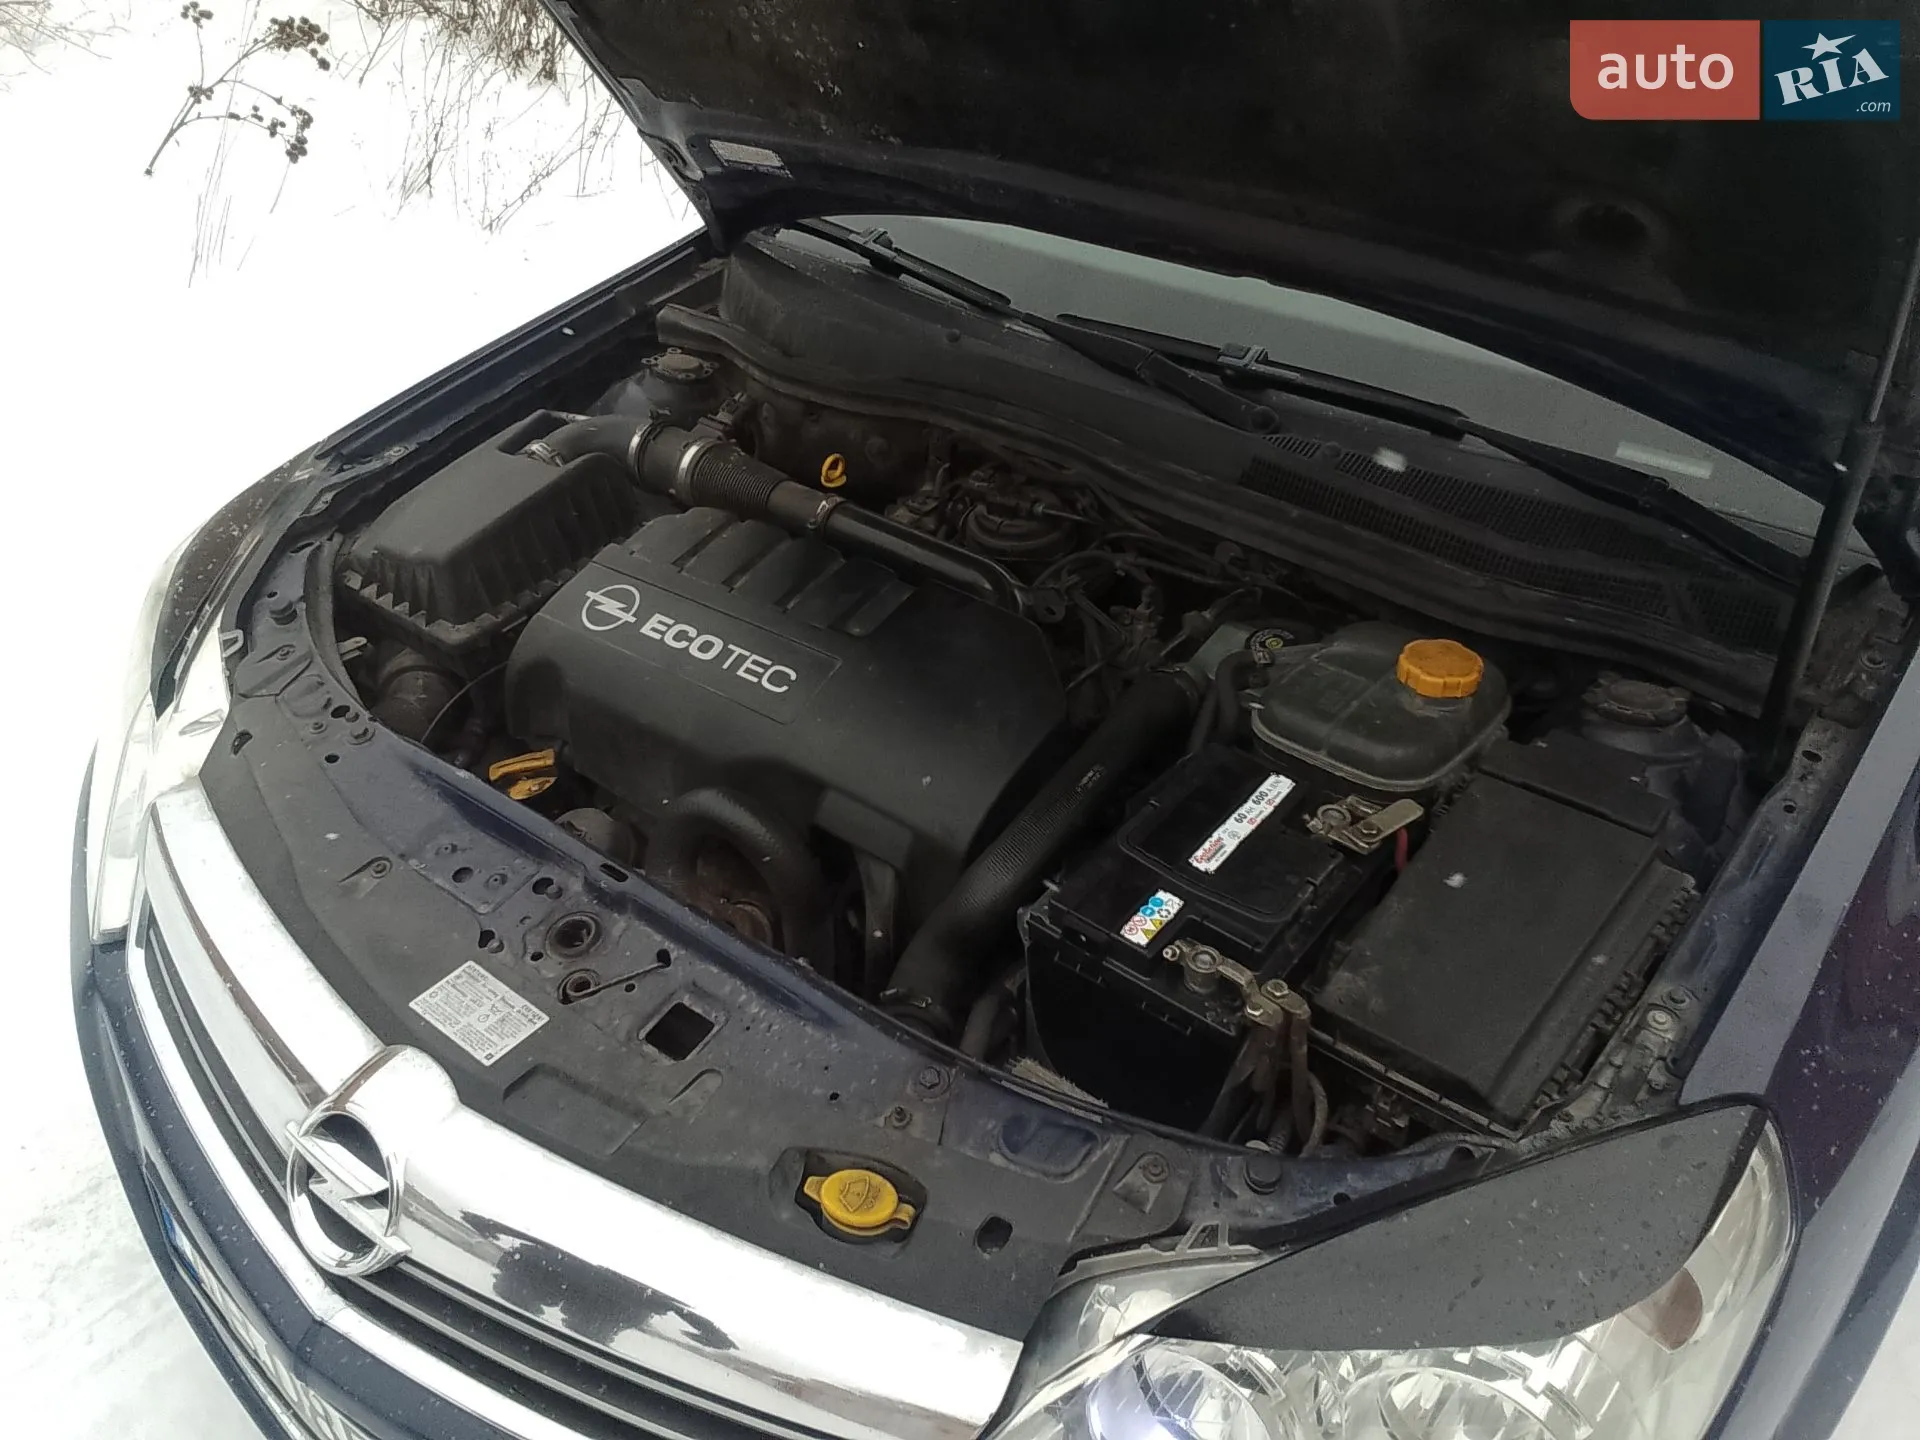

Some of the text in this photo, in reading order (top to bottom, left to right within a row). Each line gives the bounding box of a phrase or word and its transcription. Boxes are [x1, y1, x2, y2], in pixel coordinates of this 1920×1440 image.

[639, 612, 798, 694] ECOTEC
[1233, 812, 1247, 823] 60
[1251, 791, 1269, 805] 600
